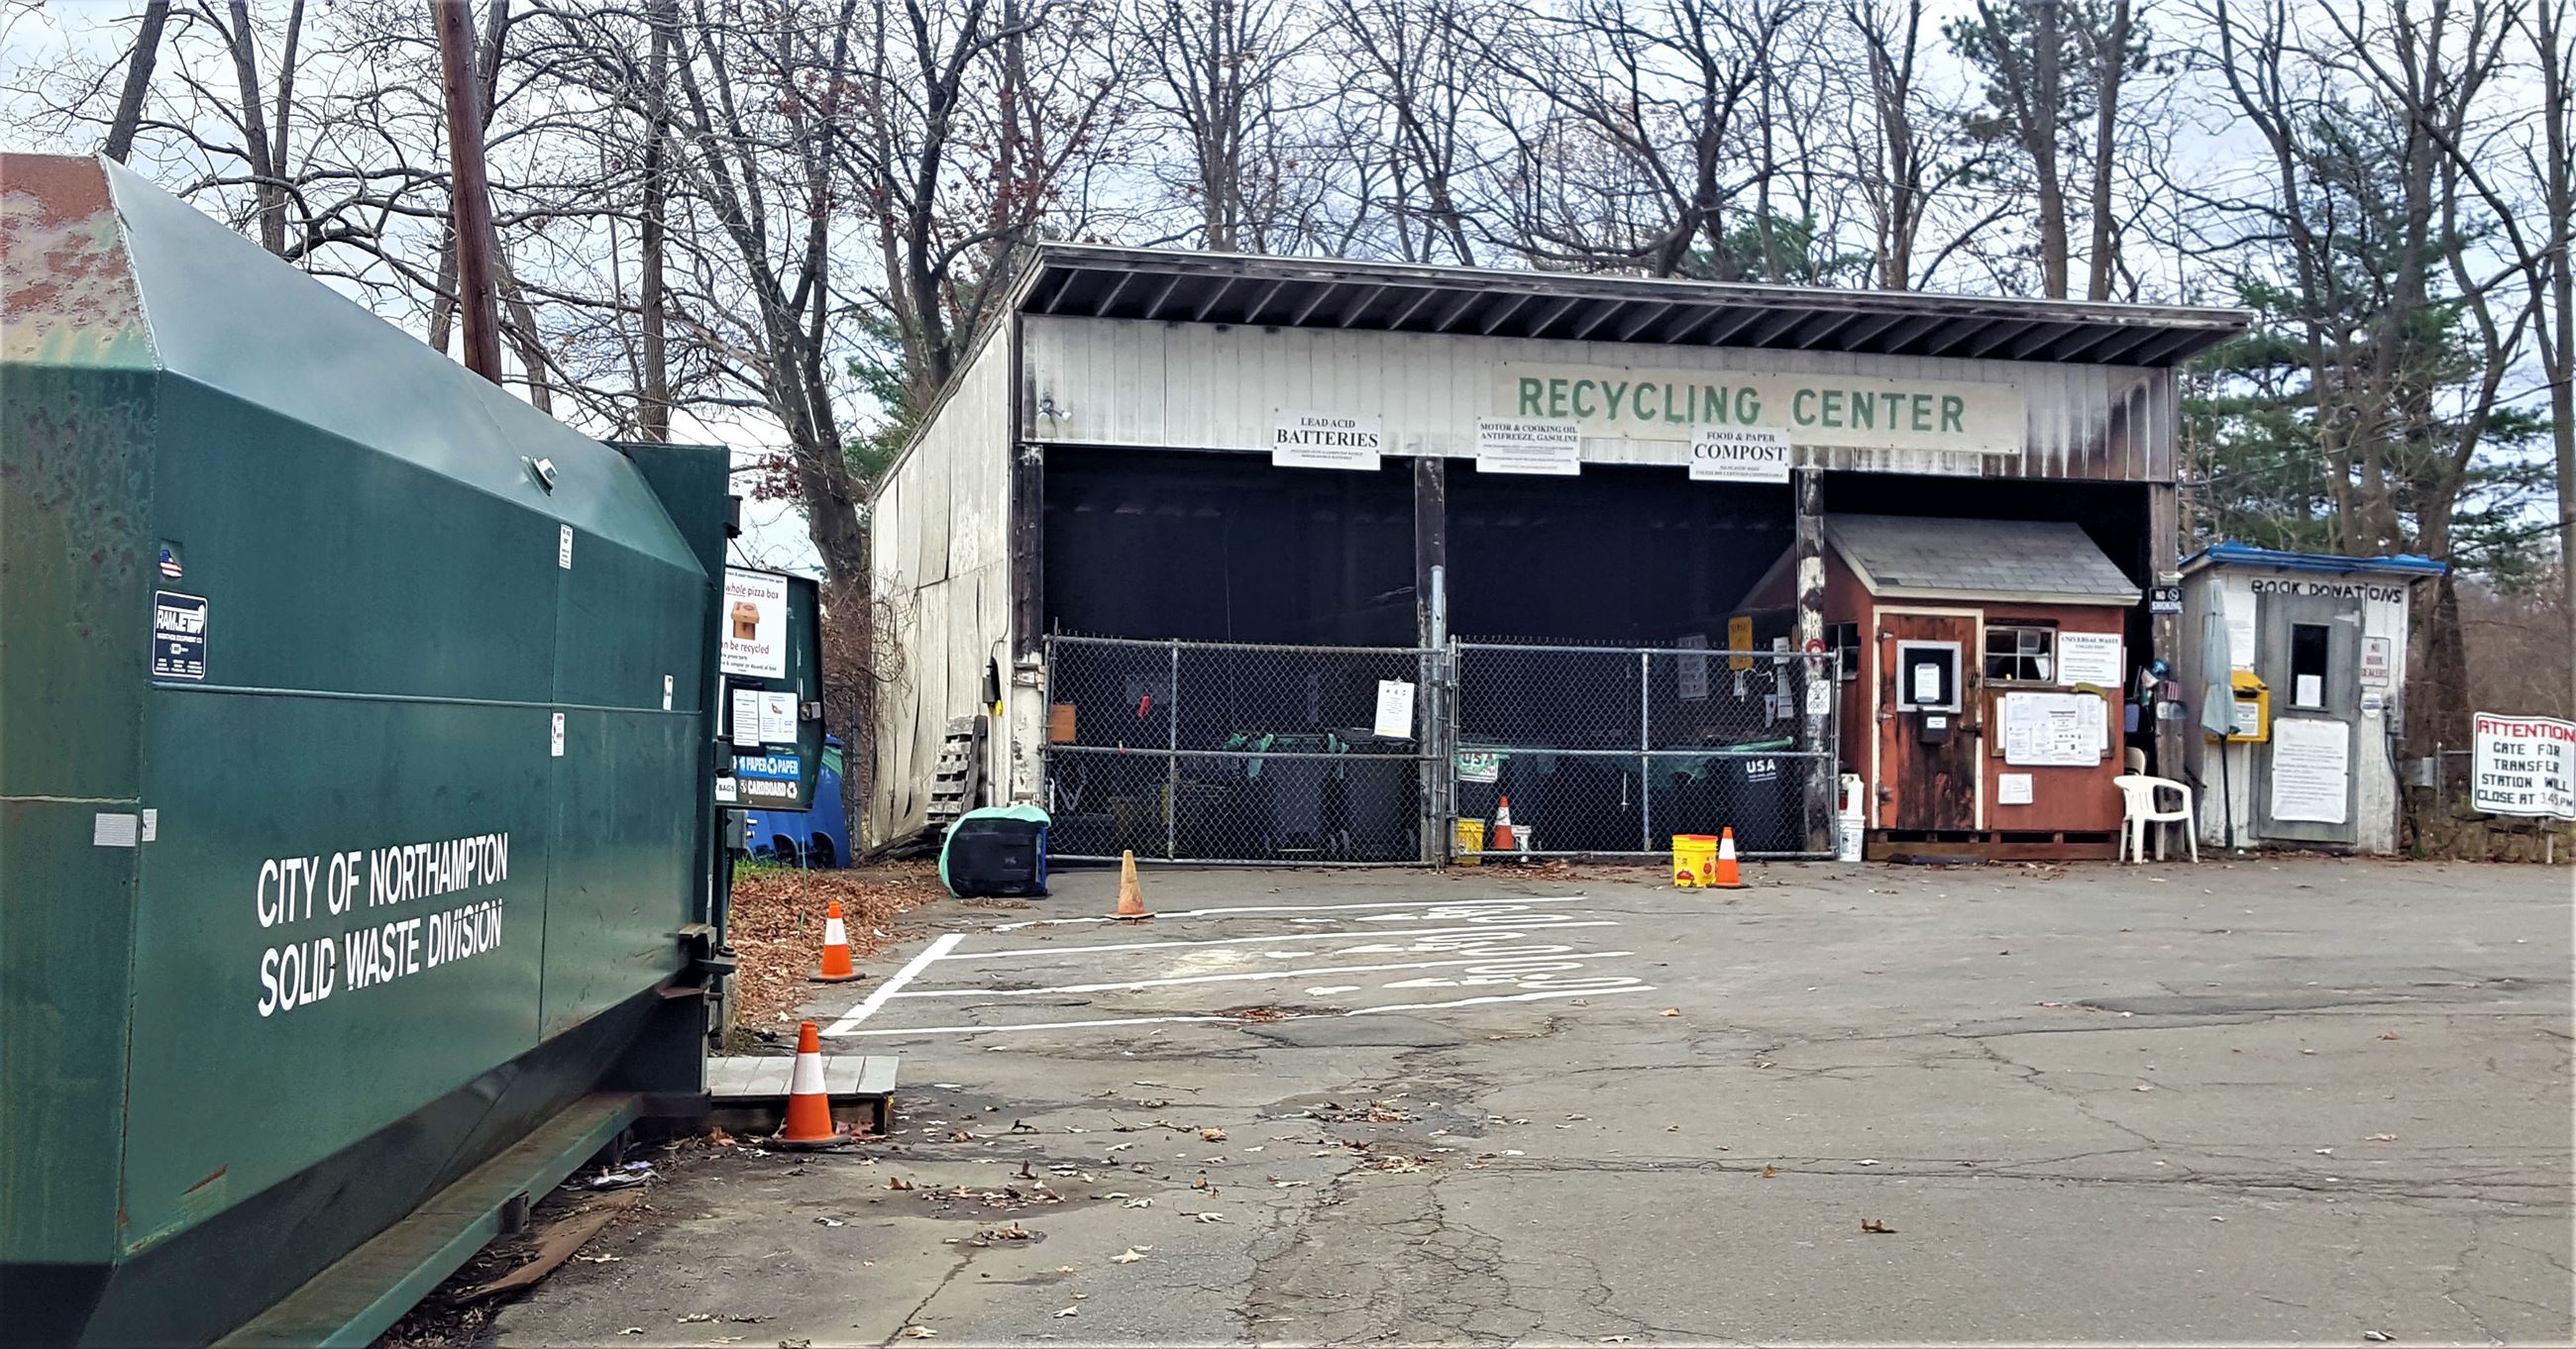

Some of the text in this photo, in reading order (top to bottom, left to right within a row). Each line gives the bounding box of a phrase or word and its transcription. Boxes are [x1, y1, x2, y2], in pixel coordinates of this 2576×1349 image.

[1518, 377, 1965, 433] RECYCLING CENTER
[1301, 417, 1355, 428] LEAD ACID
[1480, 423, 1512, 432] MOTOR
[1277, 429, 1378, 448] BATTERIES
[1480, 433, 1578, 443] ANTIFREEZE, GASOLINE
[1707, 432, 1734, 441] FOOD
[1746, 433, 1775, 443] PAPER
[1694, 443, 1787, 462] COMPOST
[725, 582, 779, 599] whole pizza box
[2251, 579, 2404, 603] BOOK DONATIONS
[729, 640, 739, 651] be
[740, 644, 770, 655] recycled
[2478, 719, 2575, 743] ATTENTION
[2493, 741, 2561, 757] GATE FOR
[746, 757, 799, 775] PAPER PAPER
[1746, 759, 1776, 774] USA
[2493, 759, 2560, 774] TRANSFER
[718, 783, 734, 792] BAGS
[747, 779, 787, 796] CARDBOARD
[2481, 773, 2570, 792] STATION WILL
[2477, 789, 2516, 804] CLOSE
[2519, 793, 2535, 804] AT
[257, 832, 508, 928] CITY OF NORTHAMPTON
[258, 898, 502, 1018] SOLID WASTE DIVISION
